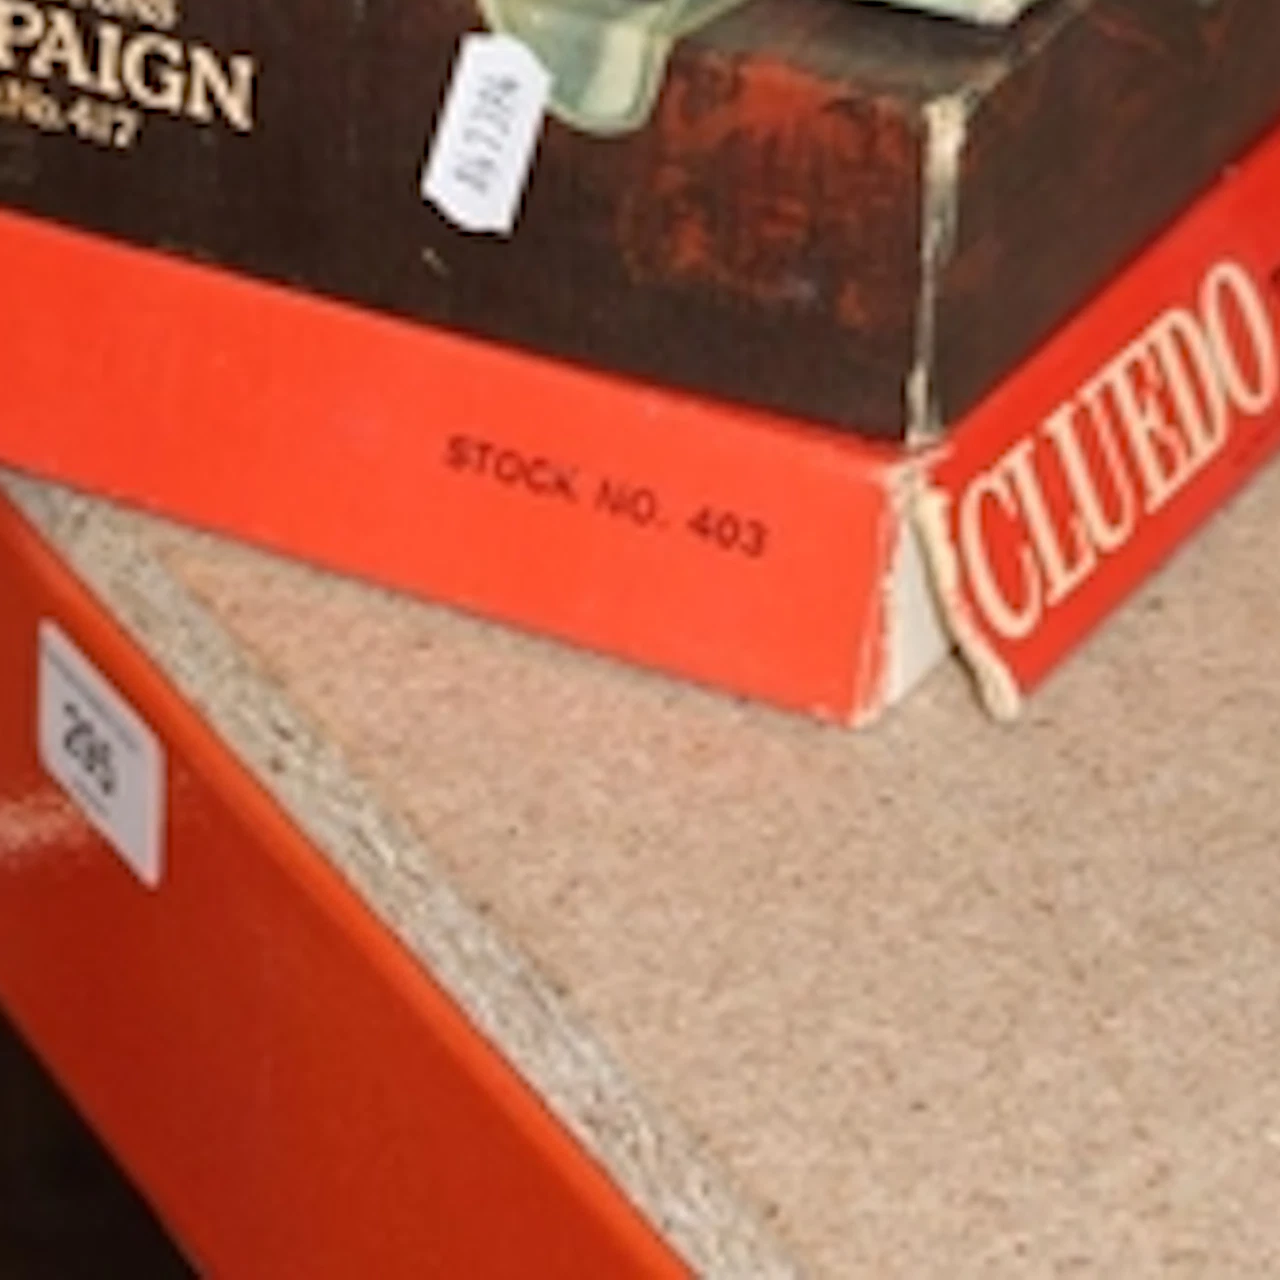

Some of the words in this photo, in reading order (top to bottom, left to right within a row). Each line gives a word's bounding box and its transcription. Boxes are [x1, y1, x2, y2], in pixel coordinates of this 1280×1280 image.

[443, 433, 580, 503] STOCK
[594, 478, 670, 530] NO.
[685, 505, 771, 560] 403
